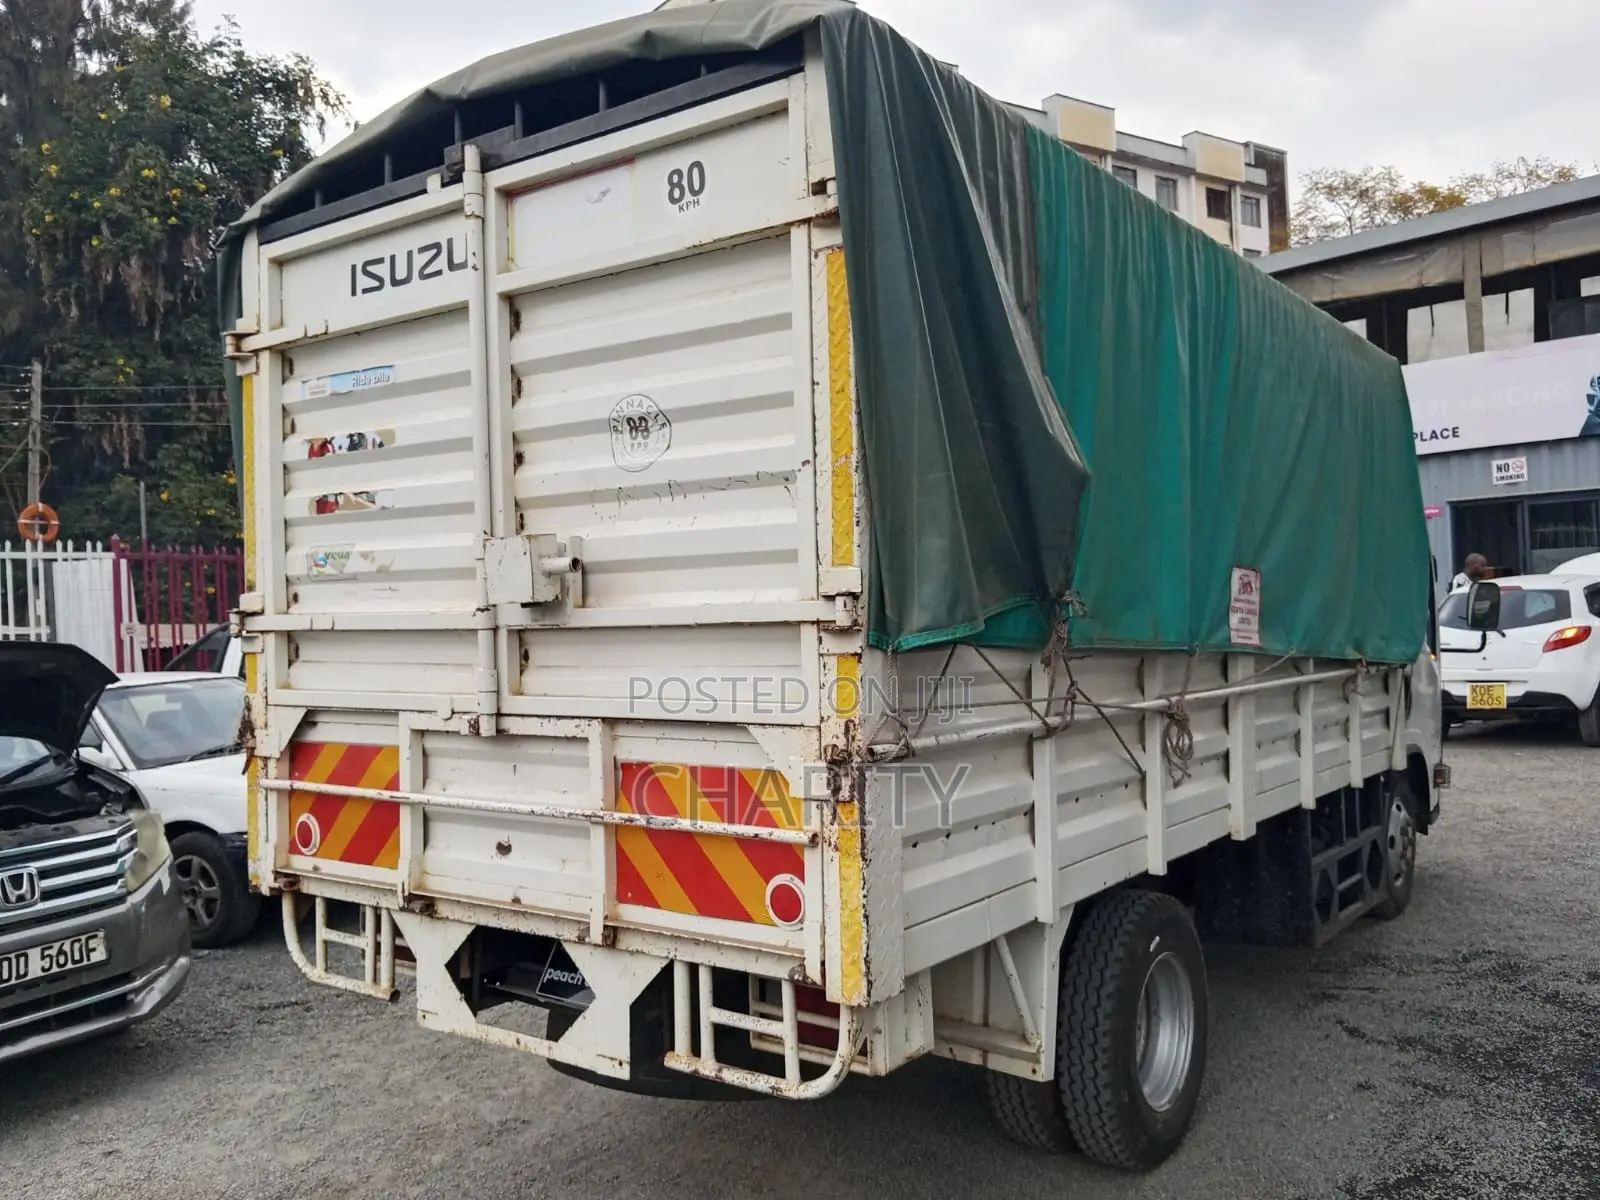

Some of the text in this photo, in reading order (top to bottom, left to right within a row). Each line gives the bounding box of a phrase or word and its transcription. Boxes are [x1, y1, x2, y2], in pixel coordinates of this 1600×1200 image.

[667, 160, 706, 206] 80
[678, 198, 700, 214] KPH
[350, 232, 468, 297] ISUZU
[1496, 462, 1510, 473] NO
[1495, 473, 1525, 482] SMOKING
[40, 934, 98, 973] 560F
[543, 967, 583, 986] peach
